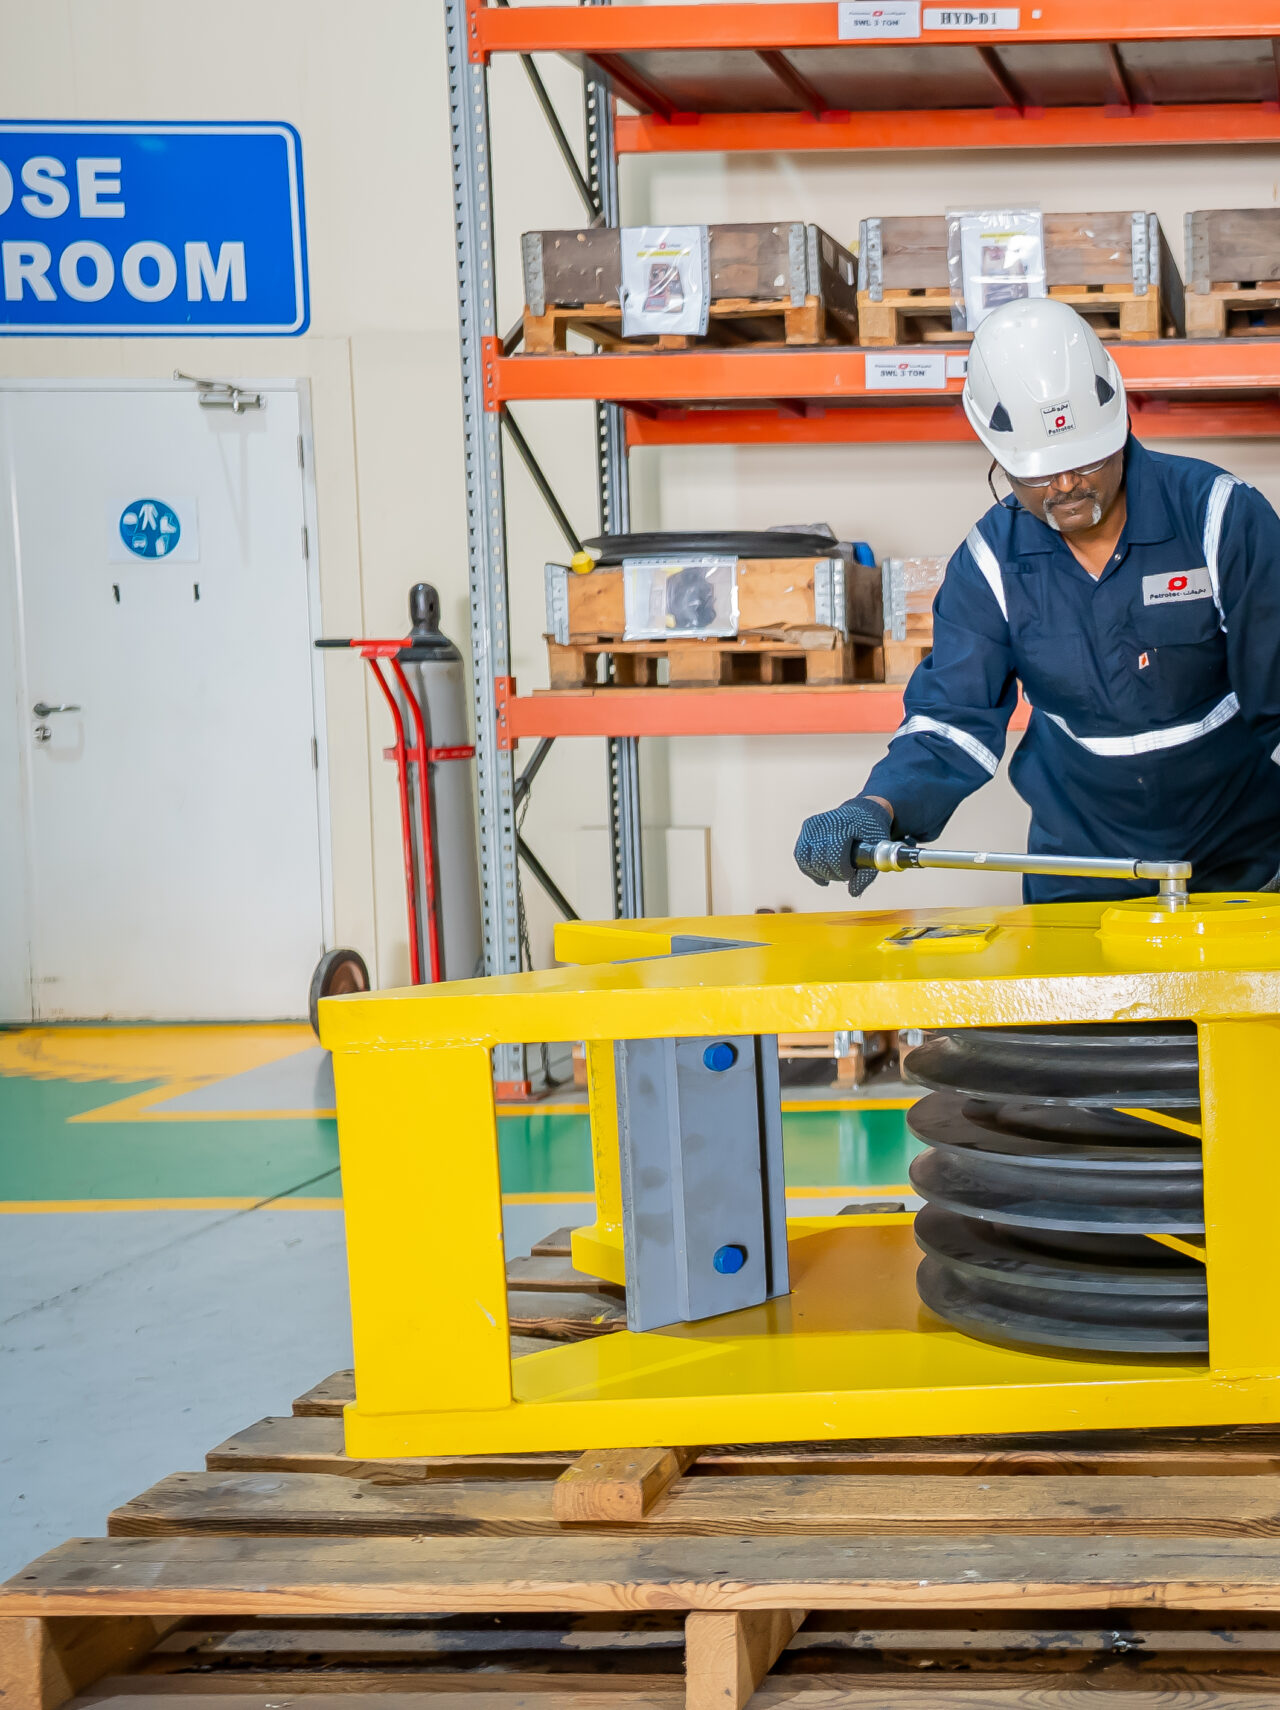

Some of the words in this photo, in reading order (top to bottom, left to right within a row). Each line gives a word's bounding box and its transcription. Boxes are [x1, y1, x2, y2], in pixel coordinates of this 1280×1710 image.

[941, 12, 996, 24] HYD-D1
[0, 156, 126, 219] SE
[2, 240, 248, 302] ROOM
[1150, 592, 1180, 600] Petrotec
